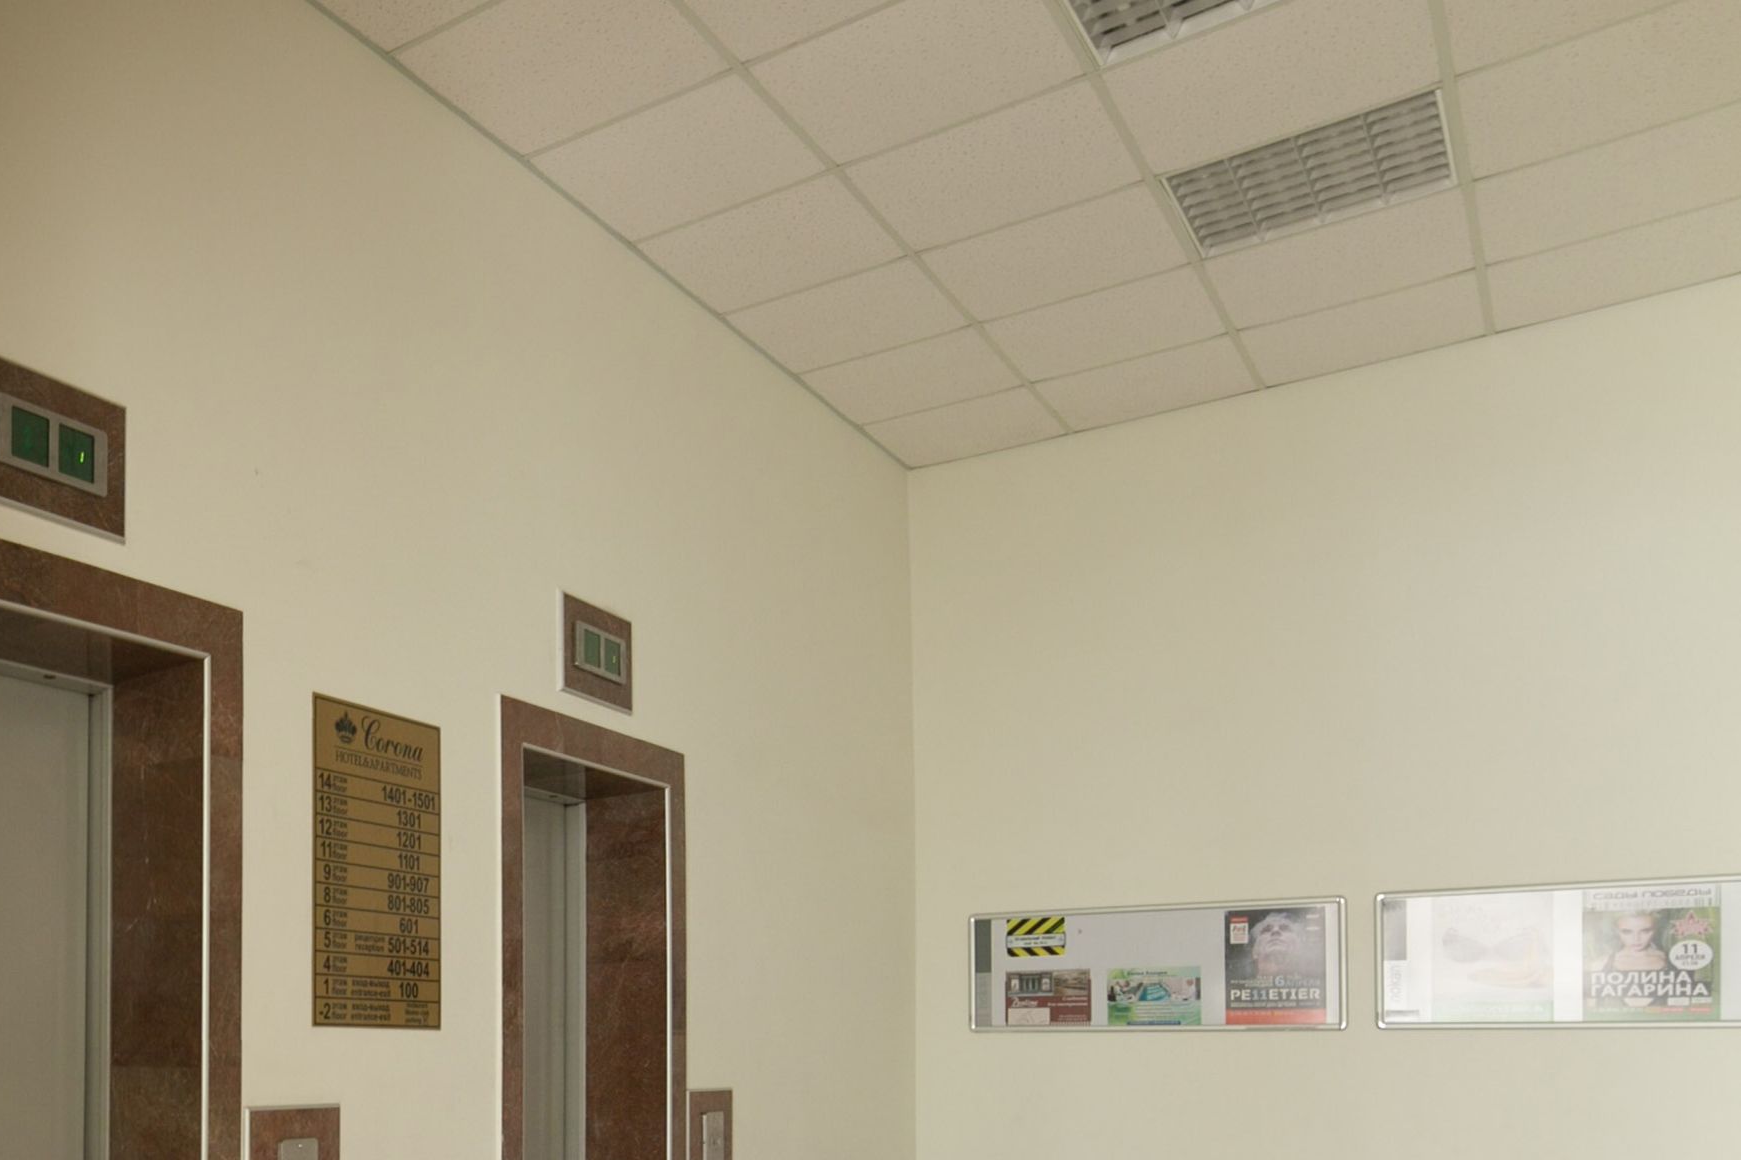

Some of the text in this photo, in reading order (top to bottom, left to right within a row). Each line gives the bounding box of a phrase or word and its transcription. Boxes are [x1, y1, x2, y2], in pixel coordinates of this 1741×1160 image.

[361, 716, 423, 762] Corona
[319, 772, 332, 790] 14
[319, 795, 332, 812] 13
[382, 785, 436, 811] 1401-1501
[319, 818, 332, 836] 12
[397, 809, 421, 829] 1301
[321, 840, 332, 858] 11
[397, 831, 421, 850] 1201
[398, 853, 420, 871] 1101
[323, 863, 332, 881] 9
[387, 873, 430, 894] 901-907
[323, 886, 332, 903] 8
[387, 895, 430, 915] 801-805
[323, 909, 332, 926] 6
[399, 918, 419, 934] 601
[323, 931, 332, 948] 5
[388, 937, 430, 956] 501-514
[1683, 944, 1698, 954] 11
[323, 955, 332, 972] 4
[387, 960, 430, 977] 401-404
[323, 978, 329, 995] 1
[1274, 975, 1285, 987] 6
[1591, 971, 1691, 985] ПОЛИНА
[399, 982, 419, 998] 100
[1591, 983, 1708, 997] ГАГАРИНА
